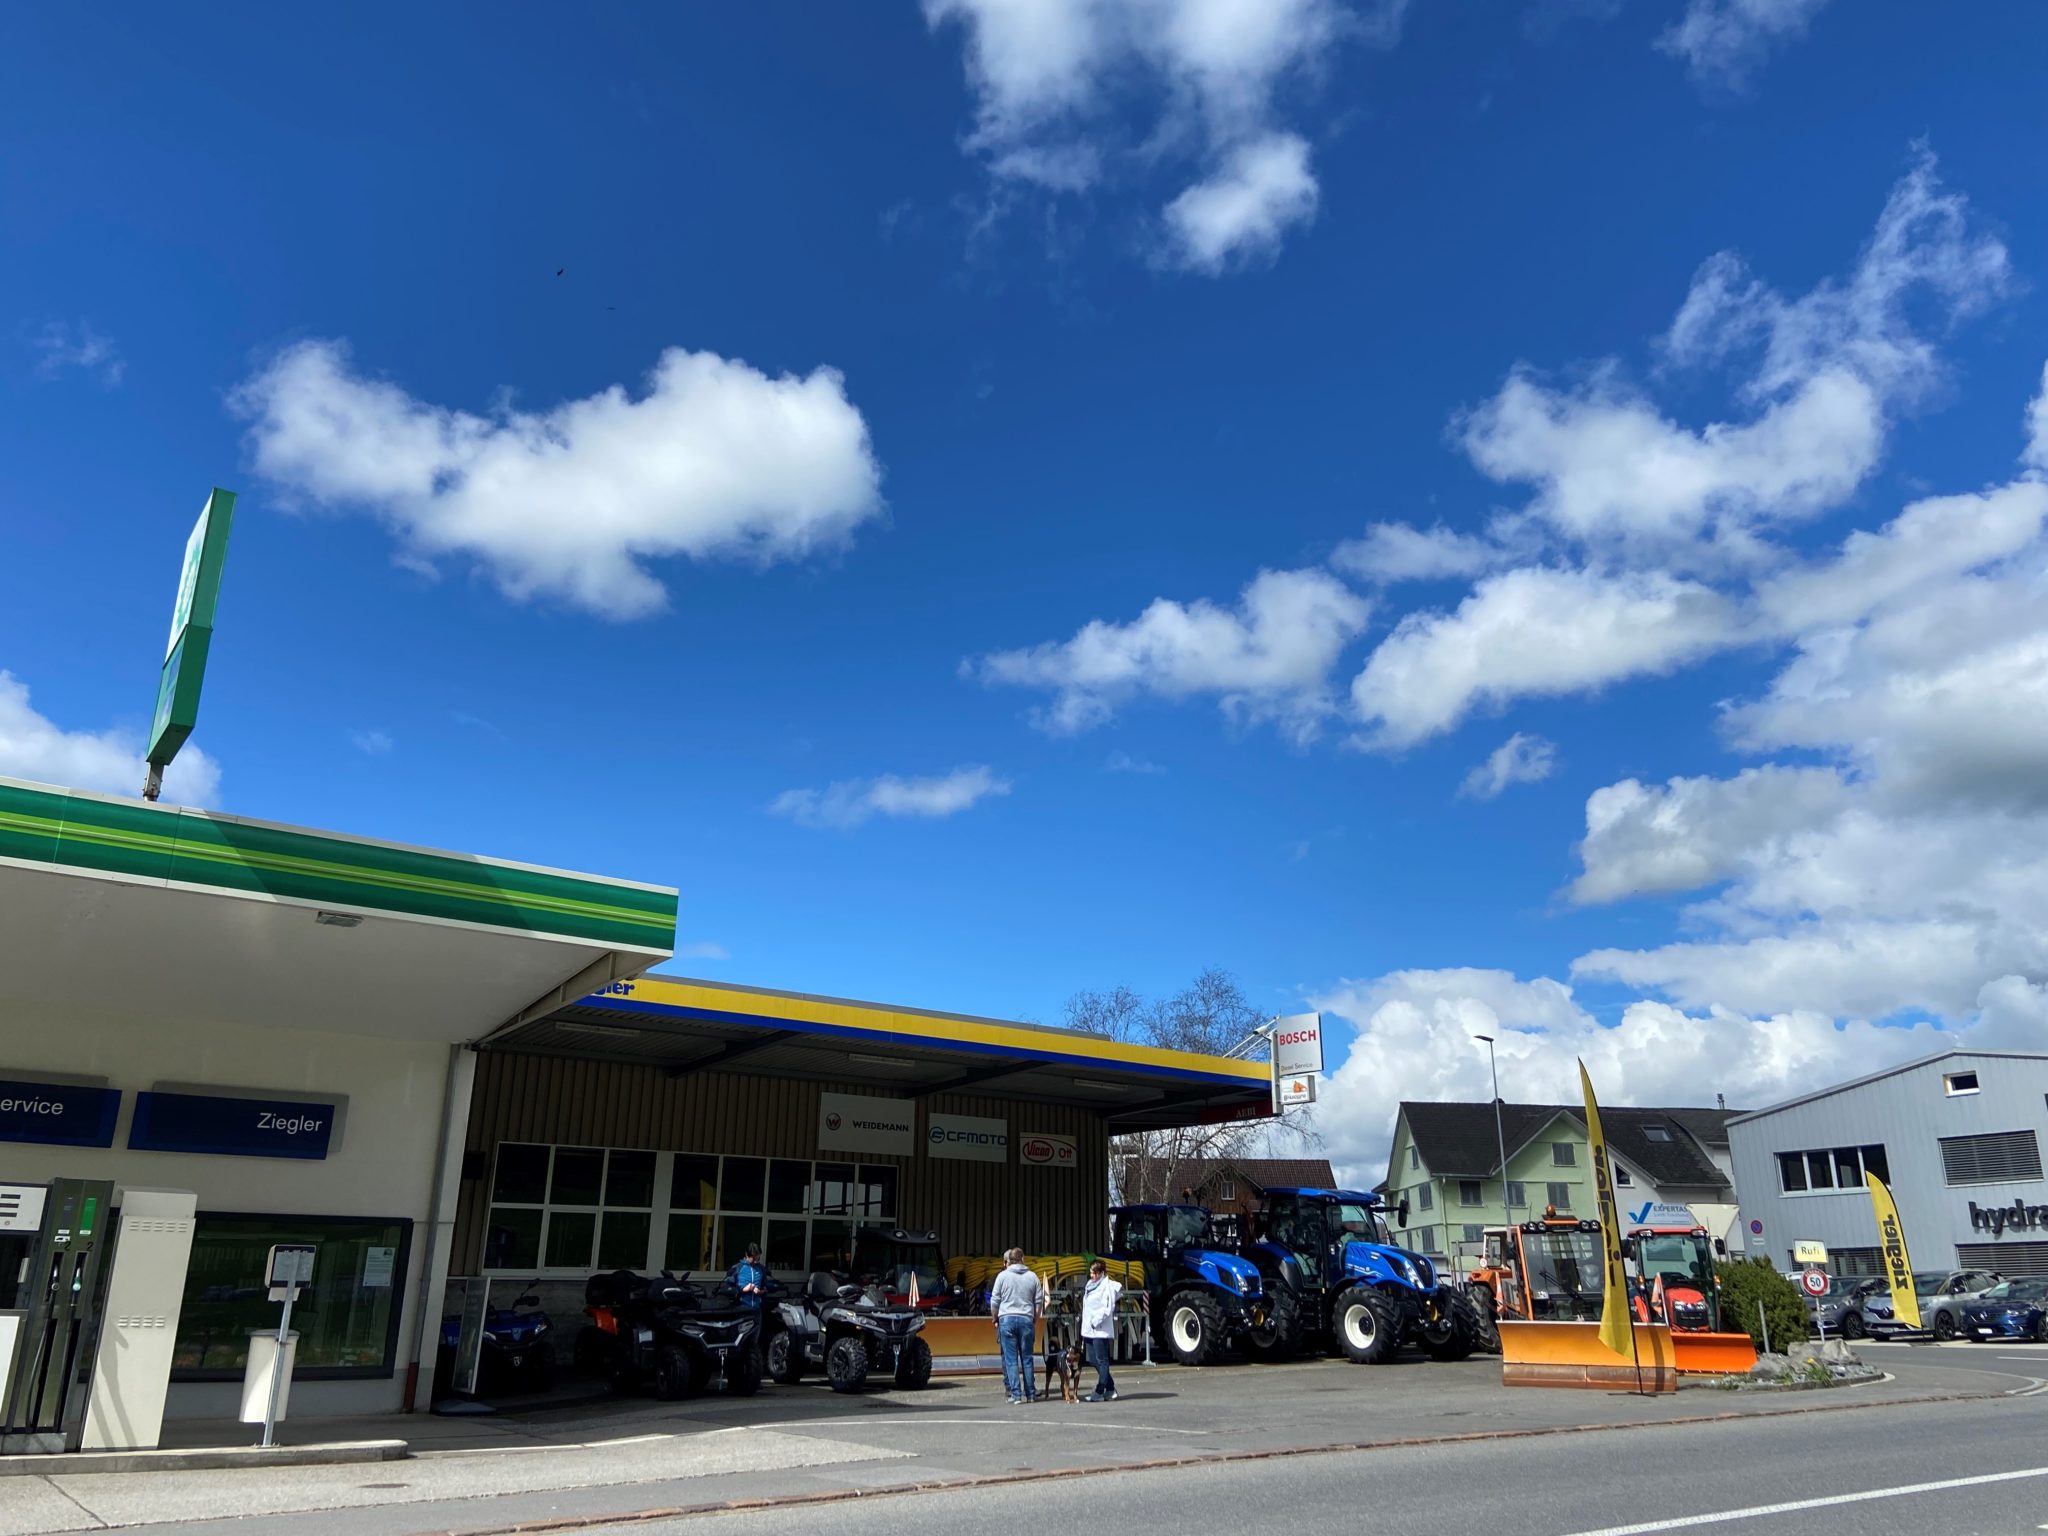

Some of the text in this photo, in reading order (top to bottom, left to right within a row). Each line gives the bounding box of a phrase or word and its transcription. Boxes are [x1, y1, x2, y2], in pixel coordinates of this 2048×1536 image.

[1280, 1030, 1316, 1045] BOSCH
[257, 1112, 323, 1135] Ziegler
[852, 1120, 909, 1132] WEIDEMANN
[946, 1130, 1008, 1146] CFMOTO
[86, 1241, 94, 1252] 2
[1801, 1245, 1821, 1256] Rufi
[1809, 1277, 1821, 1287] 50
